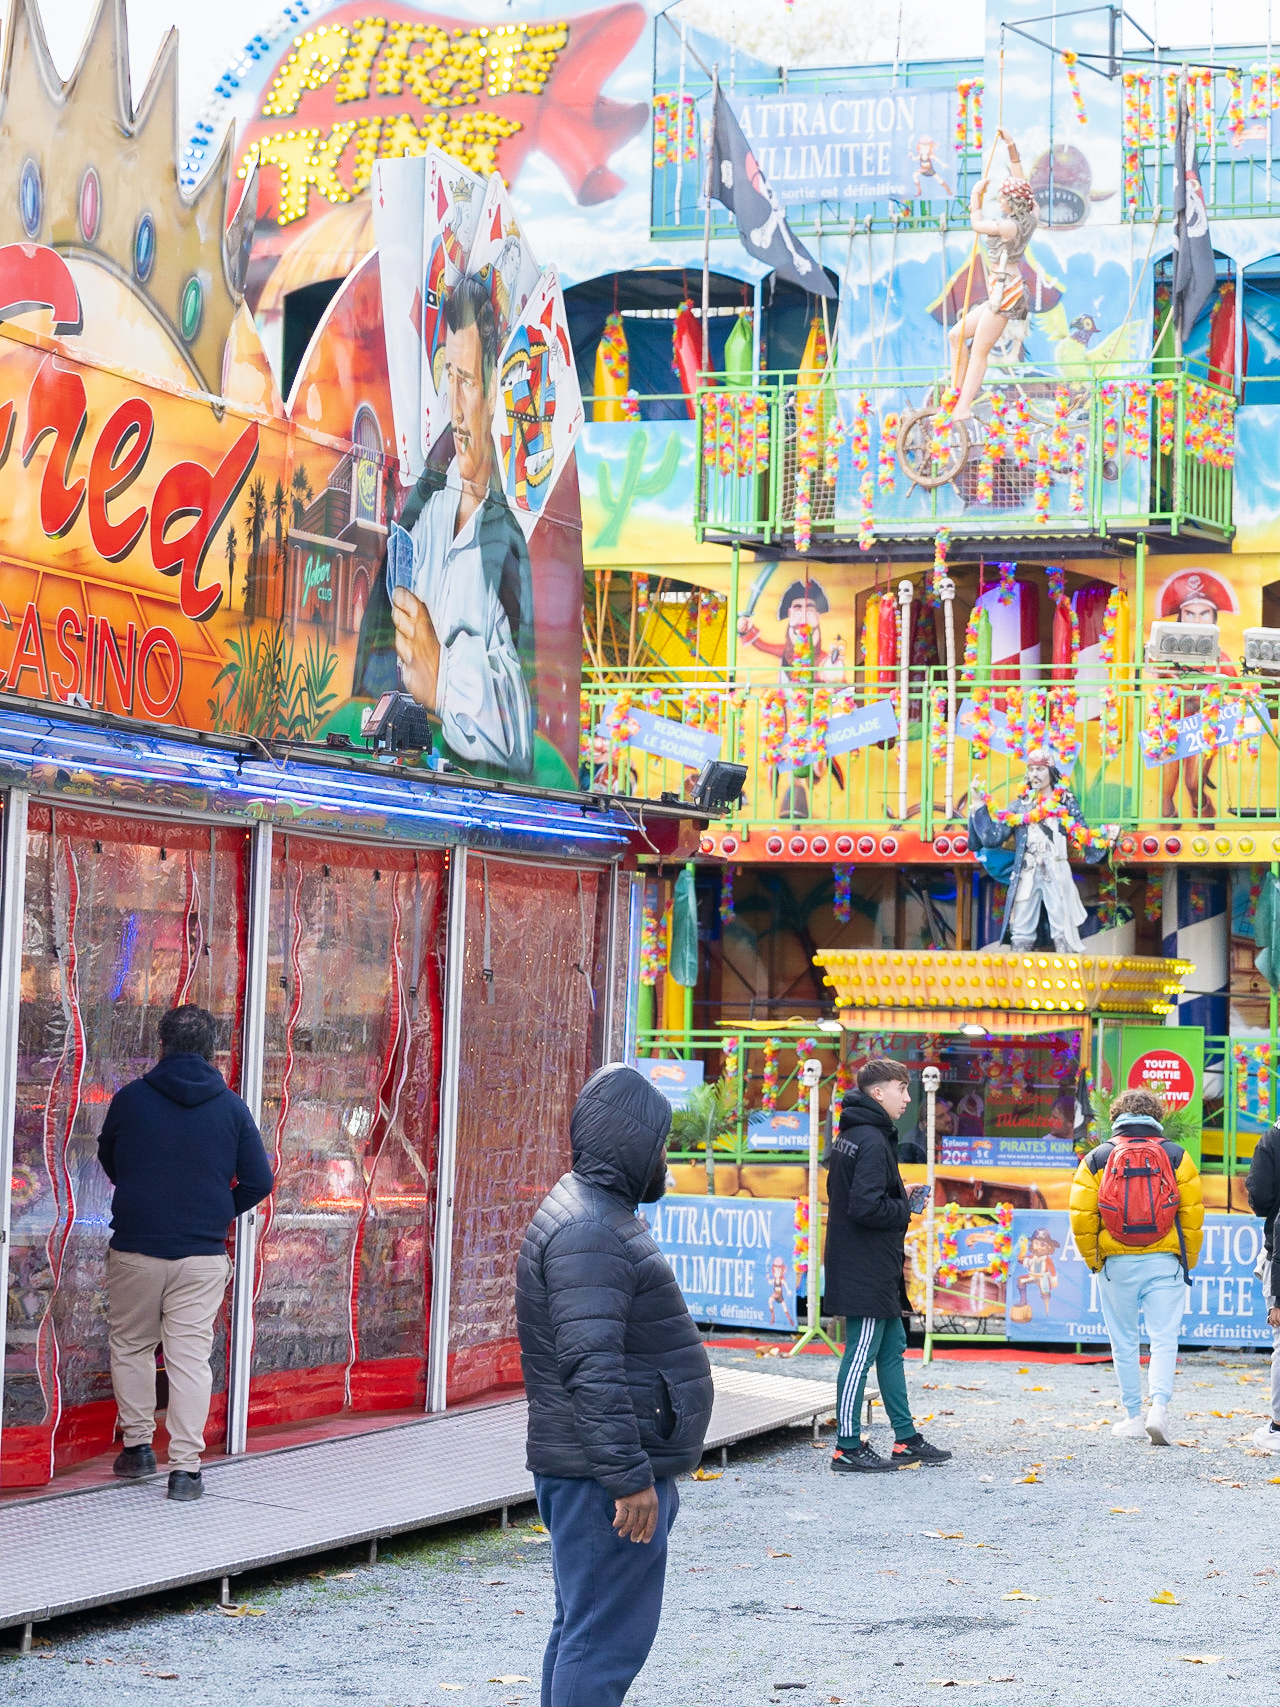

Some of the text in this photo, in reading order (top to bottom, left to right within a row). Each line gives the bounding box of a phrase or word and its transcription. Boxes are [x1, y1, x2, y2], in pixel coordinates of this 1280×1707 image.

[262, 15, 568, 119] PIRATE
[738, 96, 918, 138] ATTRACTION
[0, 602, 182, 718] ASINO
[653, 720, 706, 747] REDONNE
[1185, 723, 1230, 754] 202
[642, 734, 706, 763] LE SOURIRE
[1142, 1070, 1181, 1080] SORTIE
[1144, 1060, 1179, 1069] TOUTE
[1150, 1081, 1172, 1090] ET
[999, 1140, 1074, 1154] PIRATES KIN
[652, 1205, 772, 1249] ATTRACTION
[720, 1304, 764, 1321] définitive
[1193, 1322, 1271, 1340] définitive
